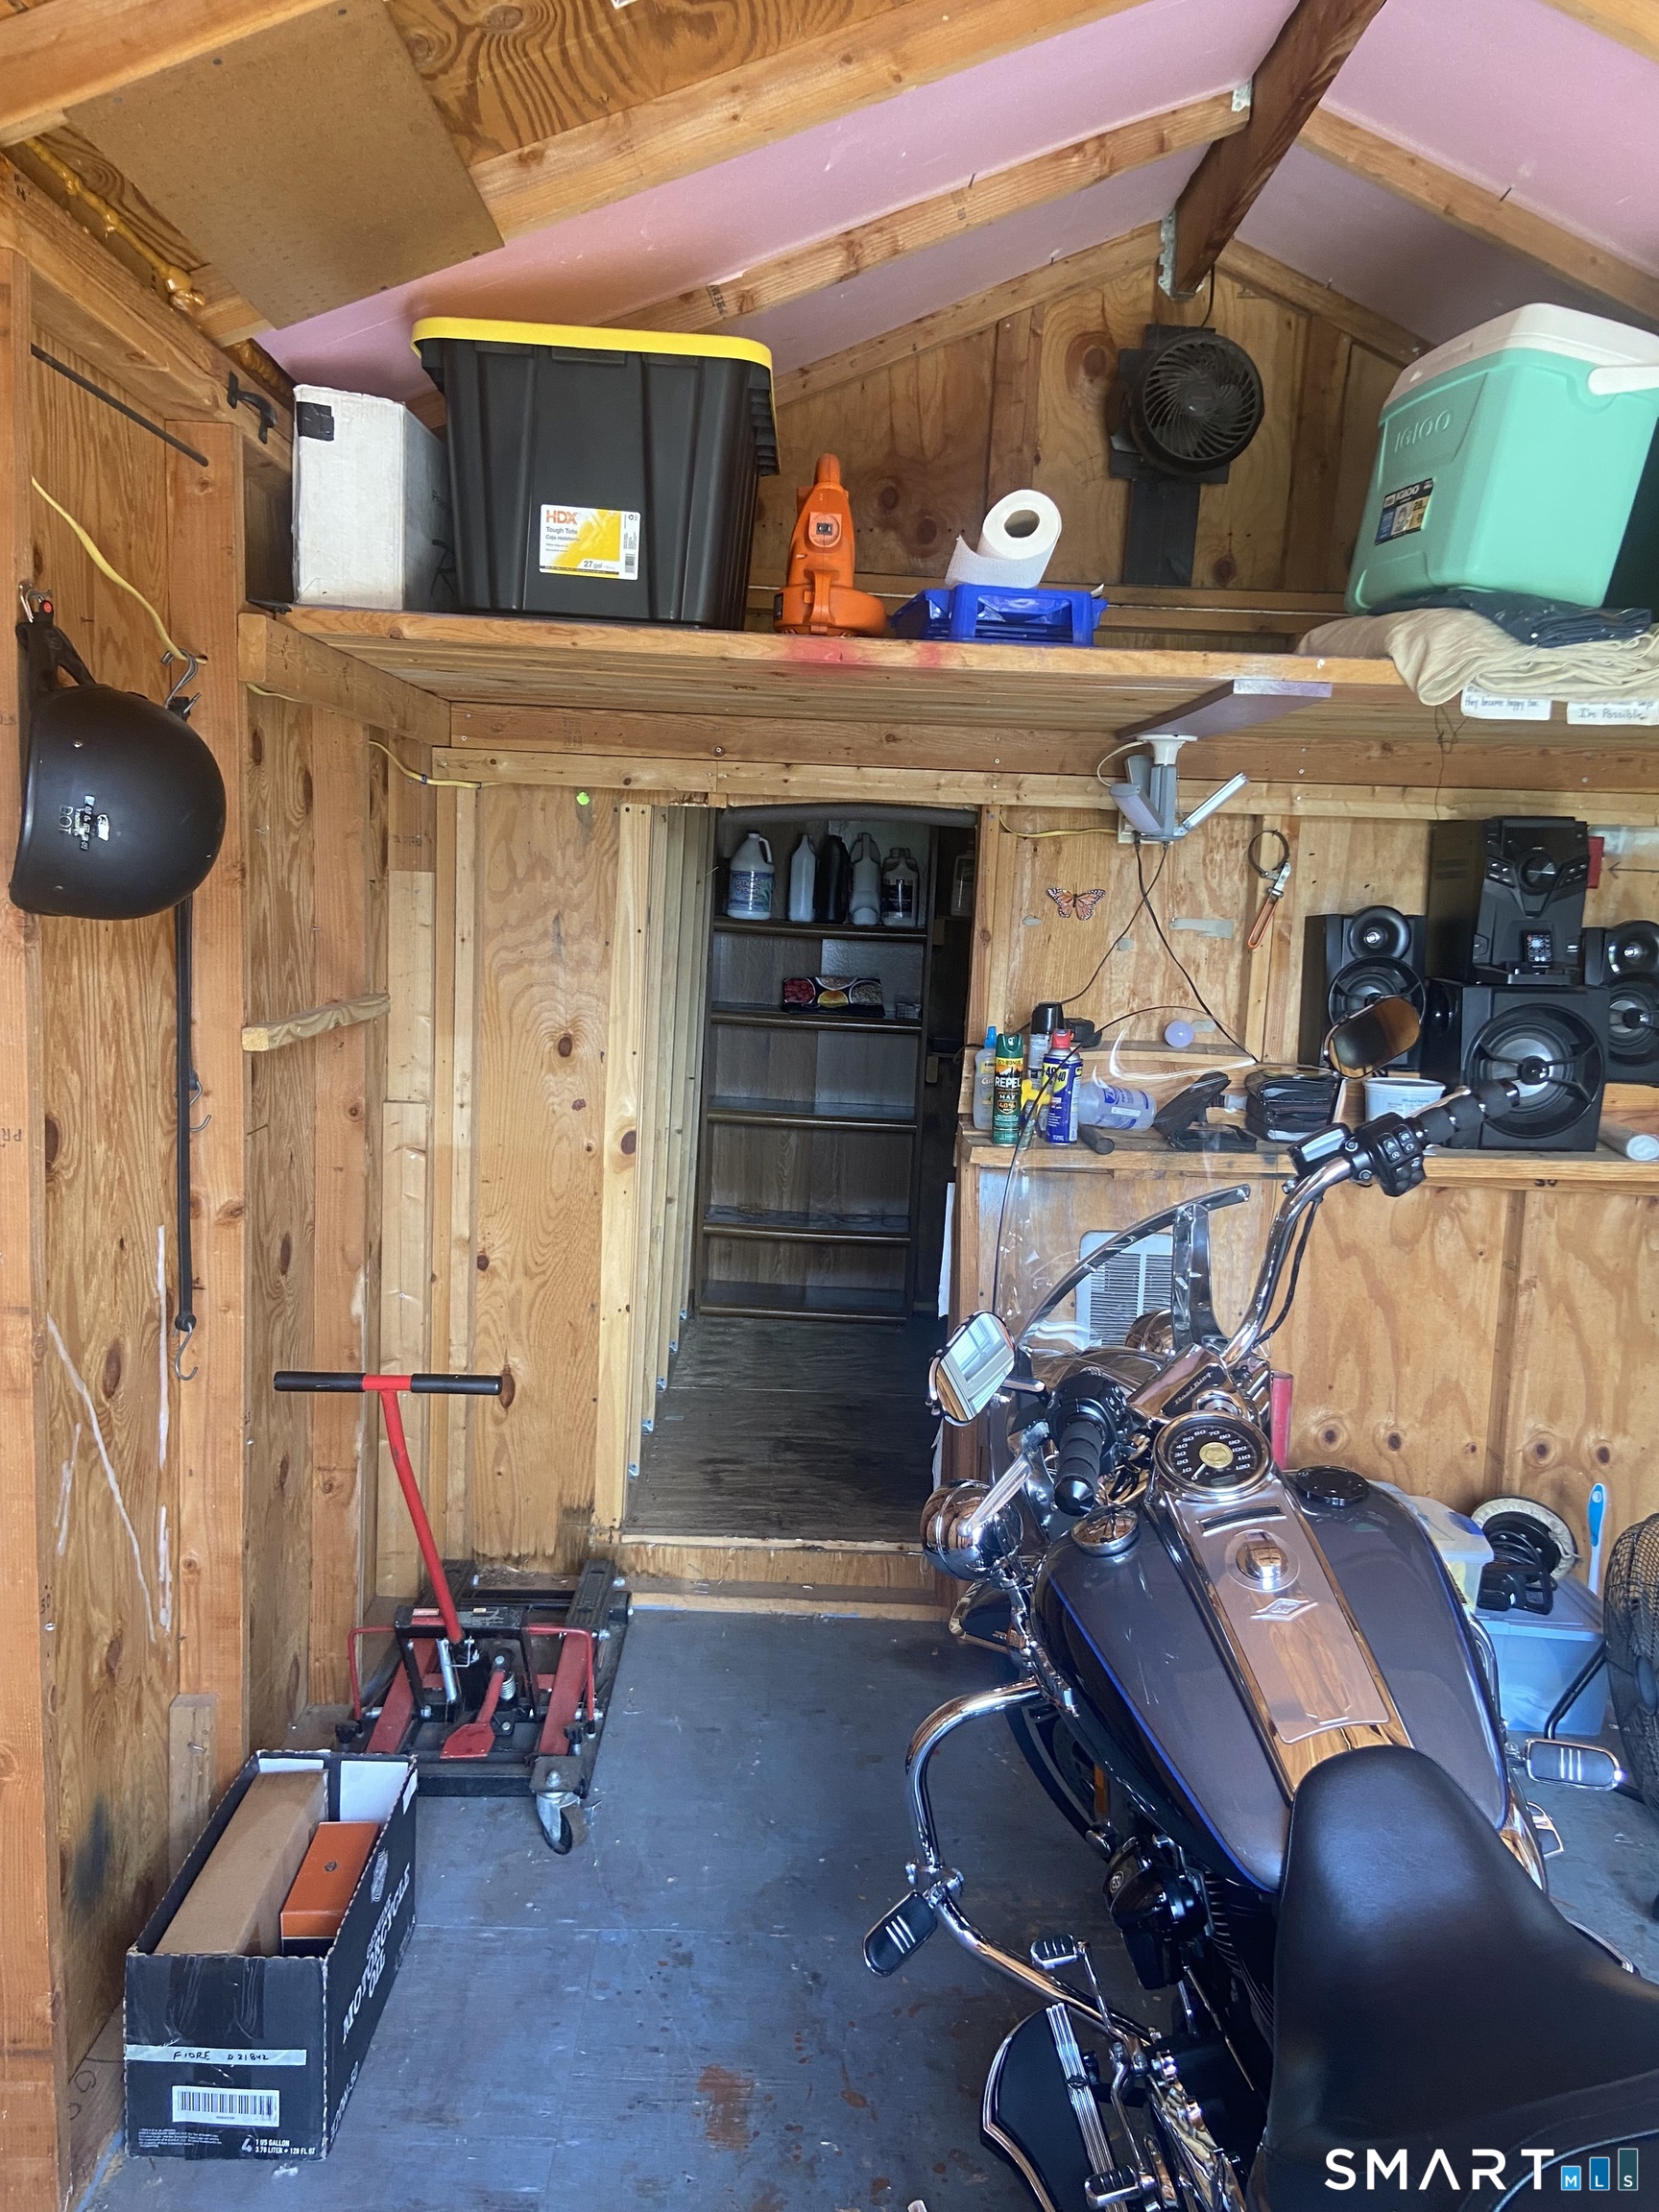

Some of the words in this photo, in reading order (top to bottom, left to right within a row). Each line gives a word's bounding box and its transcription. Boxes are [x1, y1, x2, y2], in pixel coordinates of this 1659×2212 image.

[546, 510, 578, 525] HDX
[546, 526, 565, 535] Tough
[1481, 696, 1503, 707] become
[1506, 698, 1524, 711] happy
[59, 805, 73, 835] DOT
[995, 1076, 1021, 1089] REPEL
[343, 1862, 411, 2045] MOTORCYCLE
[368, 1948, 386, 1999] OIL
[173, 2051, 210, 2060] FIORE
[241, 2137, 252, 2152] 4
